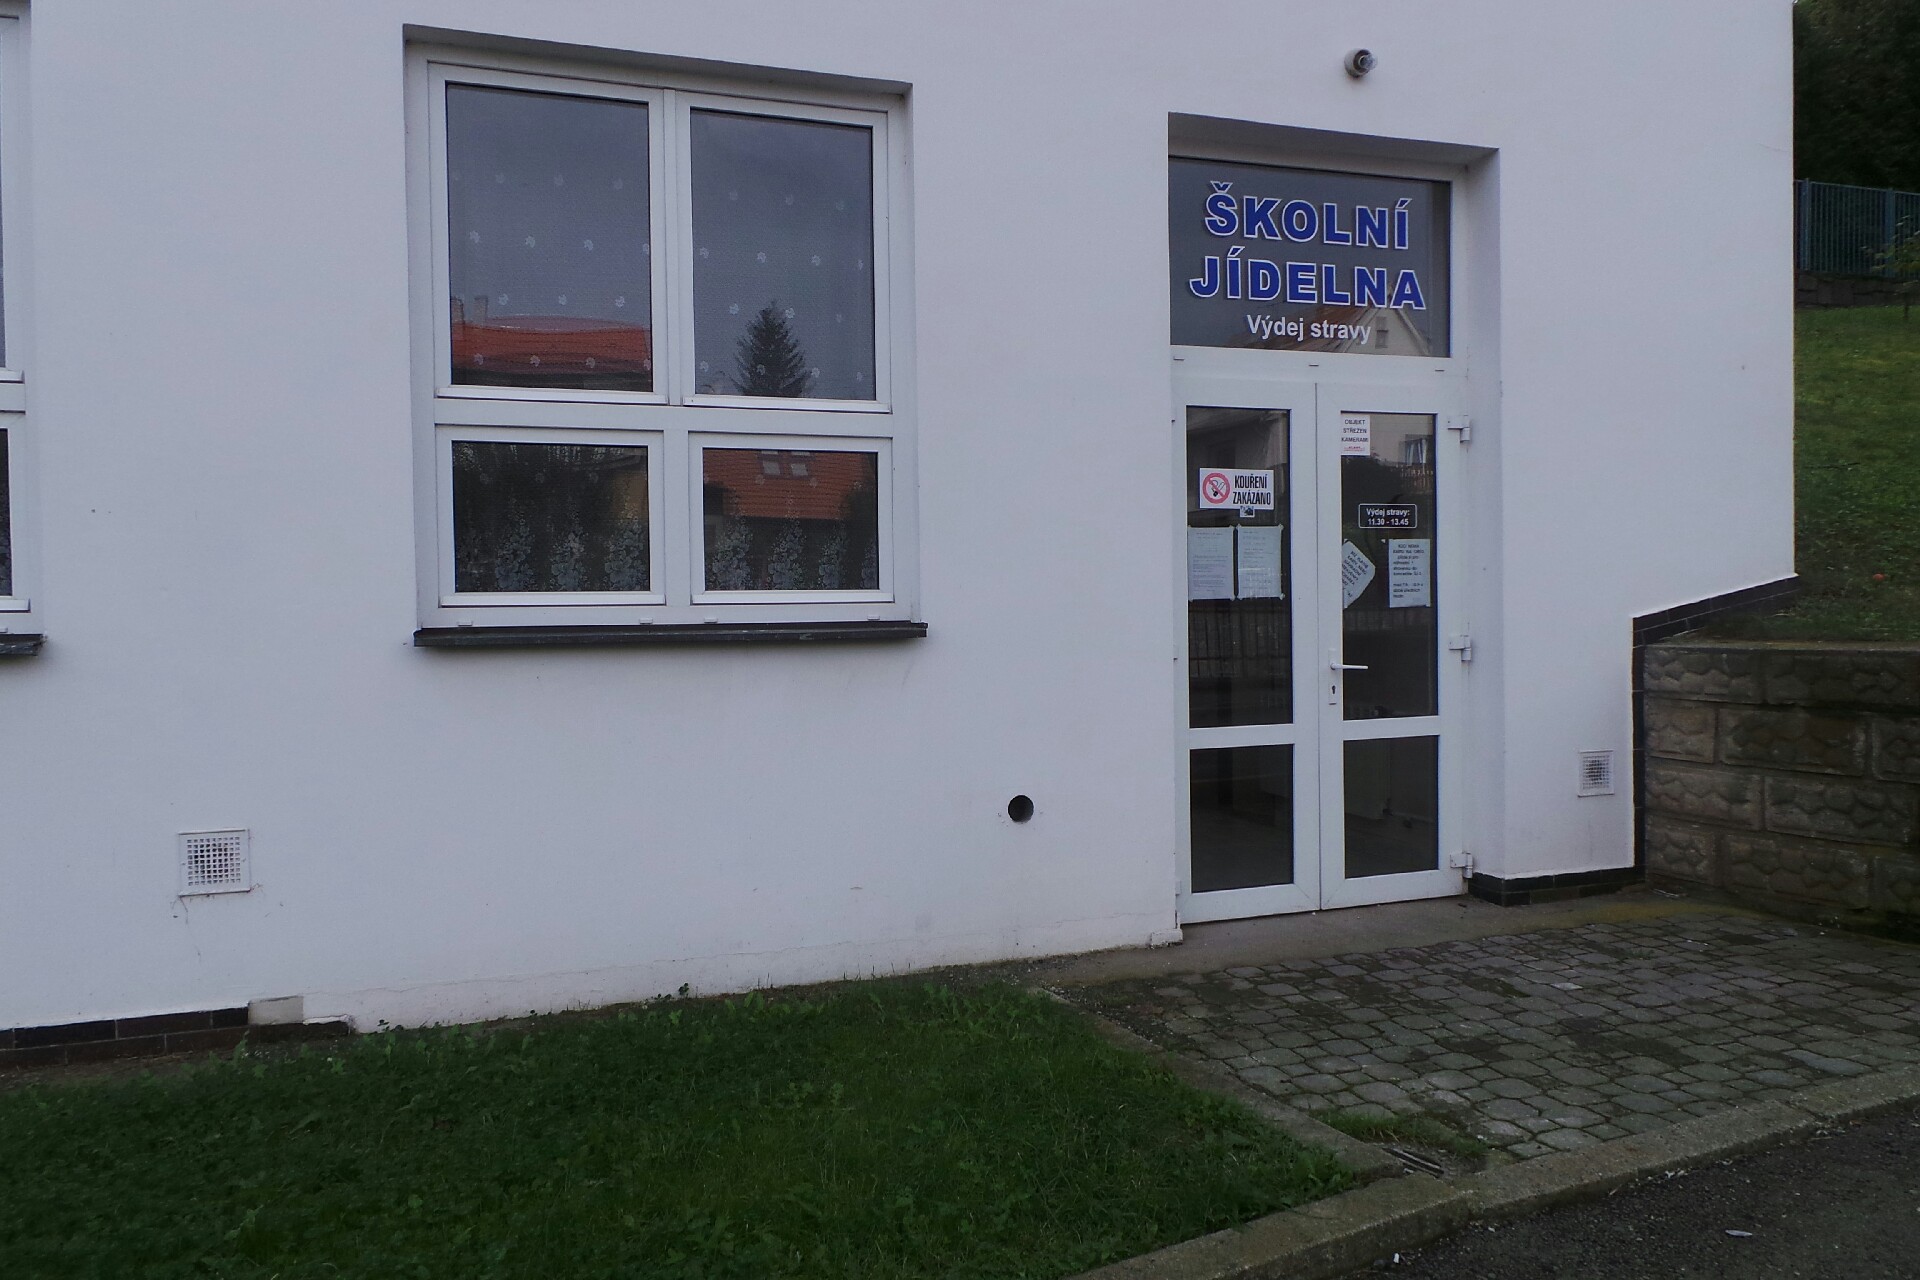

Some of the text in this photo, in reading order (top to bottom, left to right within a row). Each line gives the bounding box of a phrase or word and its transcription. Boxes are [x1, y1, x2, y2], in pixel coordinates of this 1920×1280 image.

[1204, 180, 1413, 250] ŠKOLNÍ
[1188, 245, 1427, 310] JÍDELNA
[1247, 314, 1372, 344] Výdej stravy
[1234, 473, 1268, 489] KOUŘENÍ
[1232, 490, 1272, 506] ZAKÁZÁNO
[1366, 507, 1411, 518] Výdej stravy:
[1367, 518, 1385, 526] 11.30
[1390, 518, 1409, 526] 13.45
